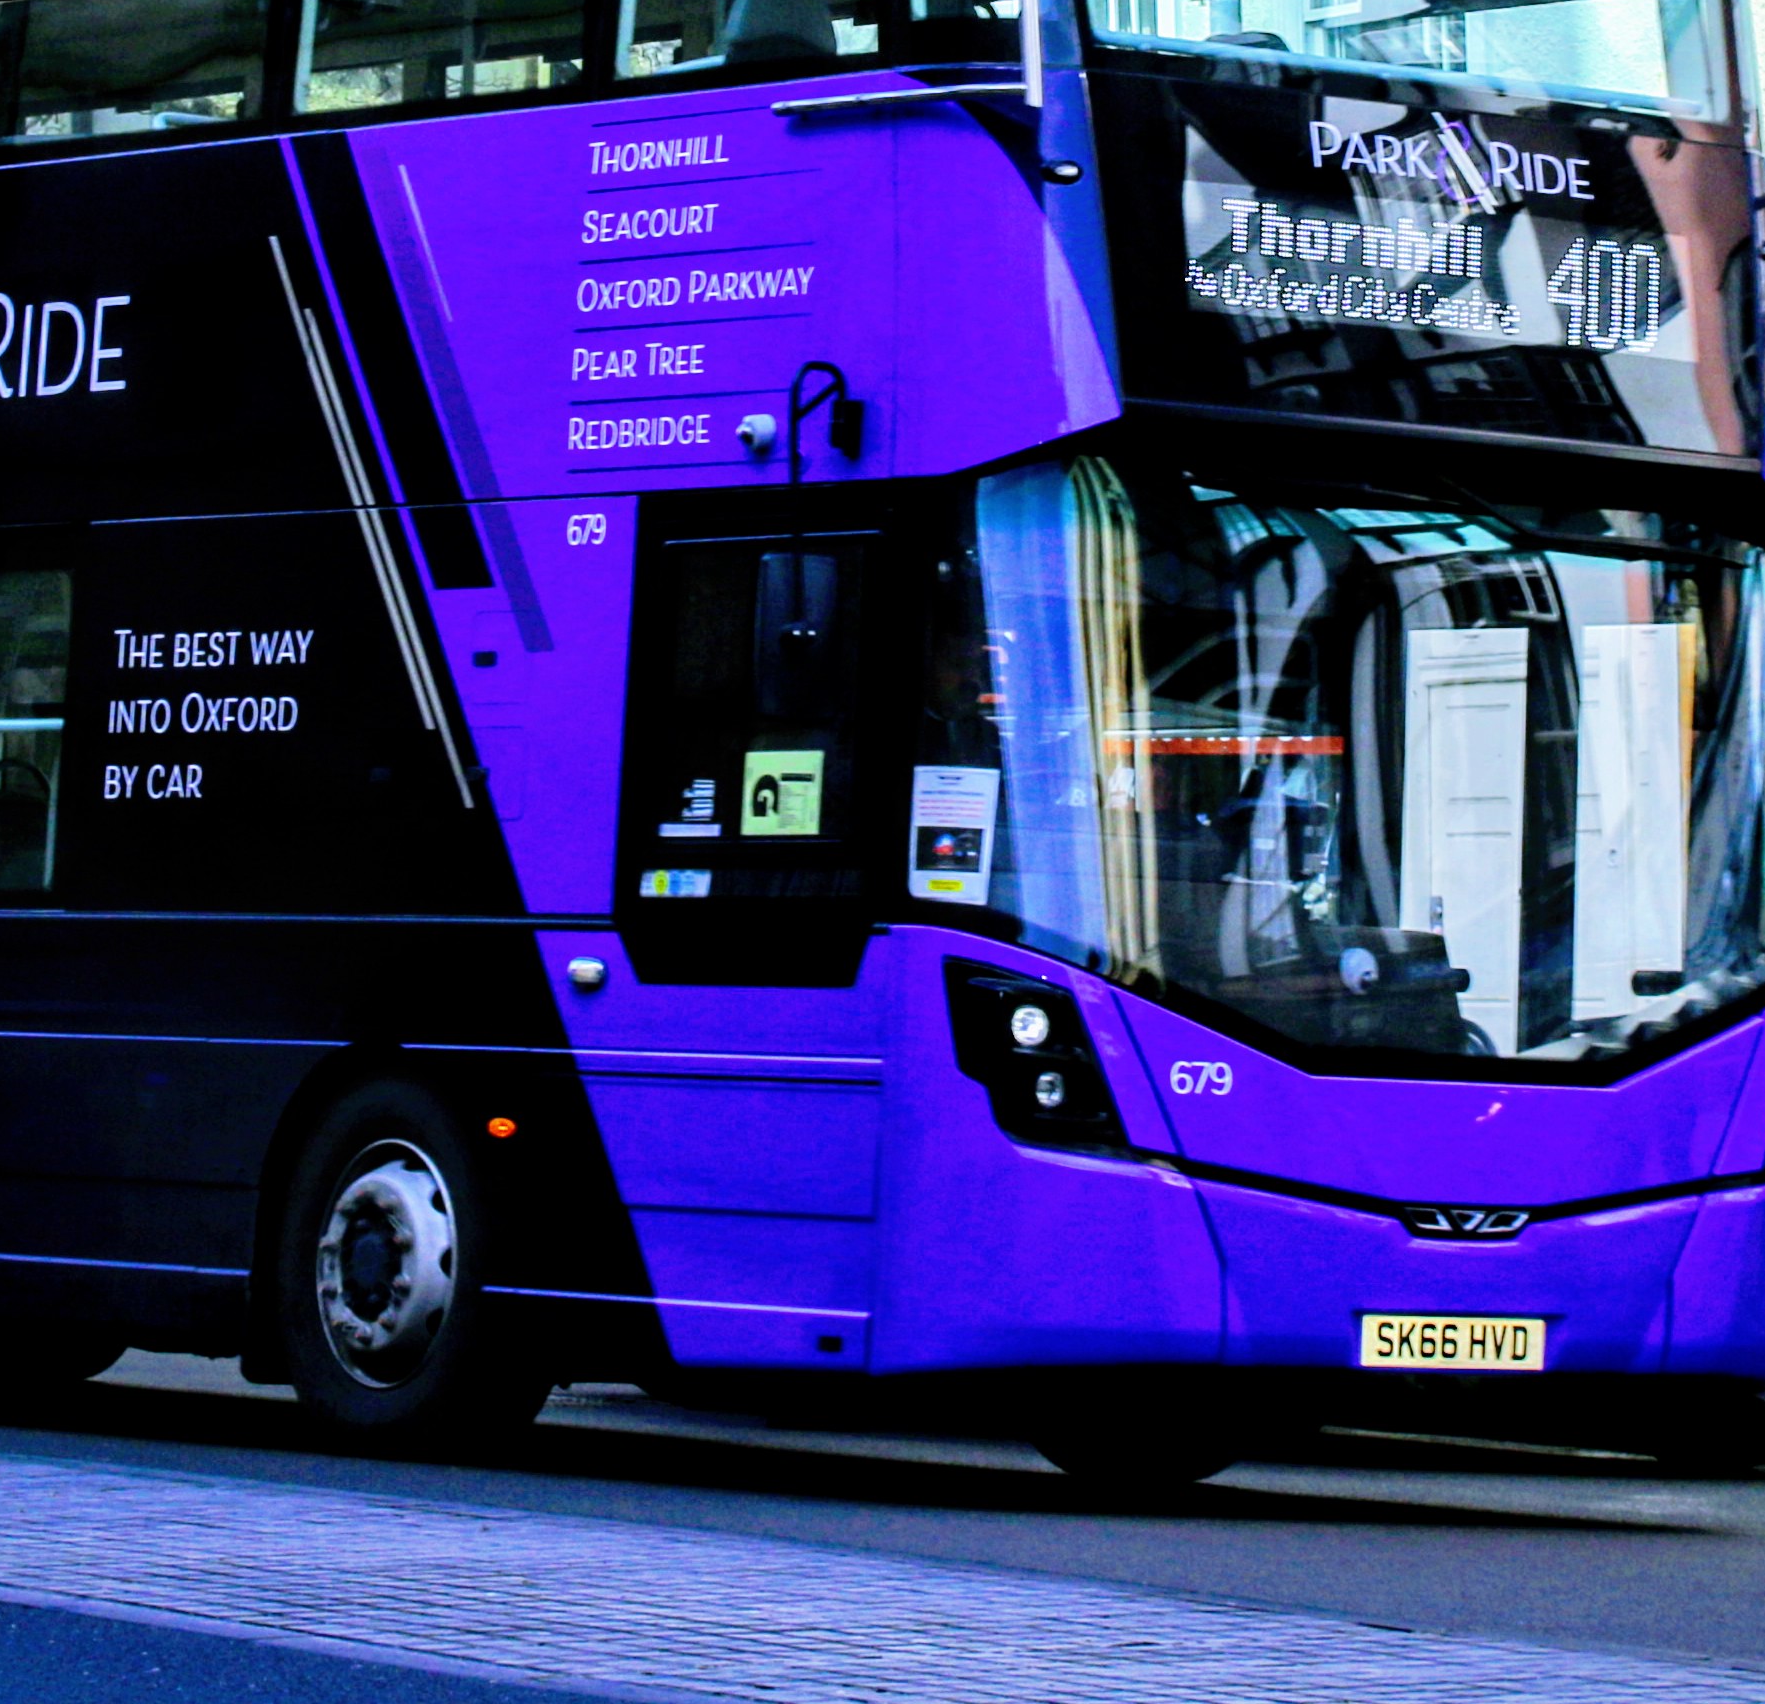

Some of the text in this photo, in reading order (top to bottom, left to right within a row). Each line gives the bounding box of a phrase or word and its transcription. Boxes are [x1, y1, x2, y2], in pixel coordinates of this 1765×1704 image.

[589, 134, 729, 175] THORNHILL
[1309, 121, 1437, 180] PARK
[1488, 140, 1595, 200] RIDE
[581, 203, 719, 244] SEACOURT
[1221, 198, 1483, 279] Thornhill
[576, 265, 815, 313] OXFORD PARKWAY
[1221, 263, 1339, 315] Oxford
[1546, 236, 1661, 353] 400
[571, 343, 706, 381] PEAR TREE
[567, 413, 712, 451] REDBRIDGE
[566, 513, 607, 546] 679
[114, 629, 315, 669] THE BEST WAY
[107, 692, 299, 734] INTO OXFORD
[103, 763, 204, 800] BY CAR
[1169, 1060, 1234, 1096] 679
[1377, 1321, 1528, 1361] SK66 HVD
